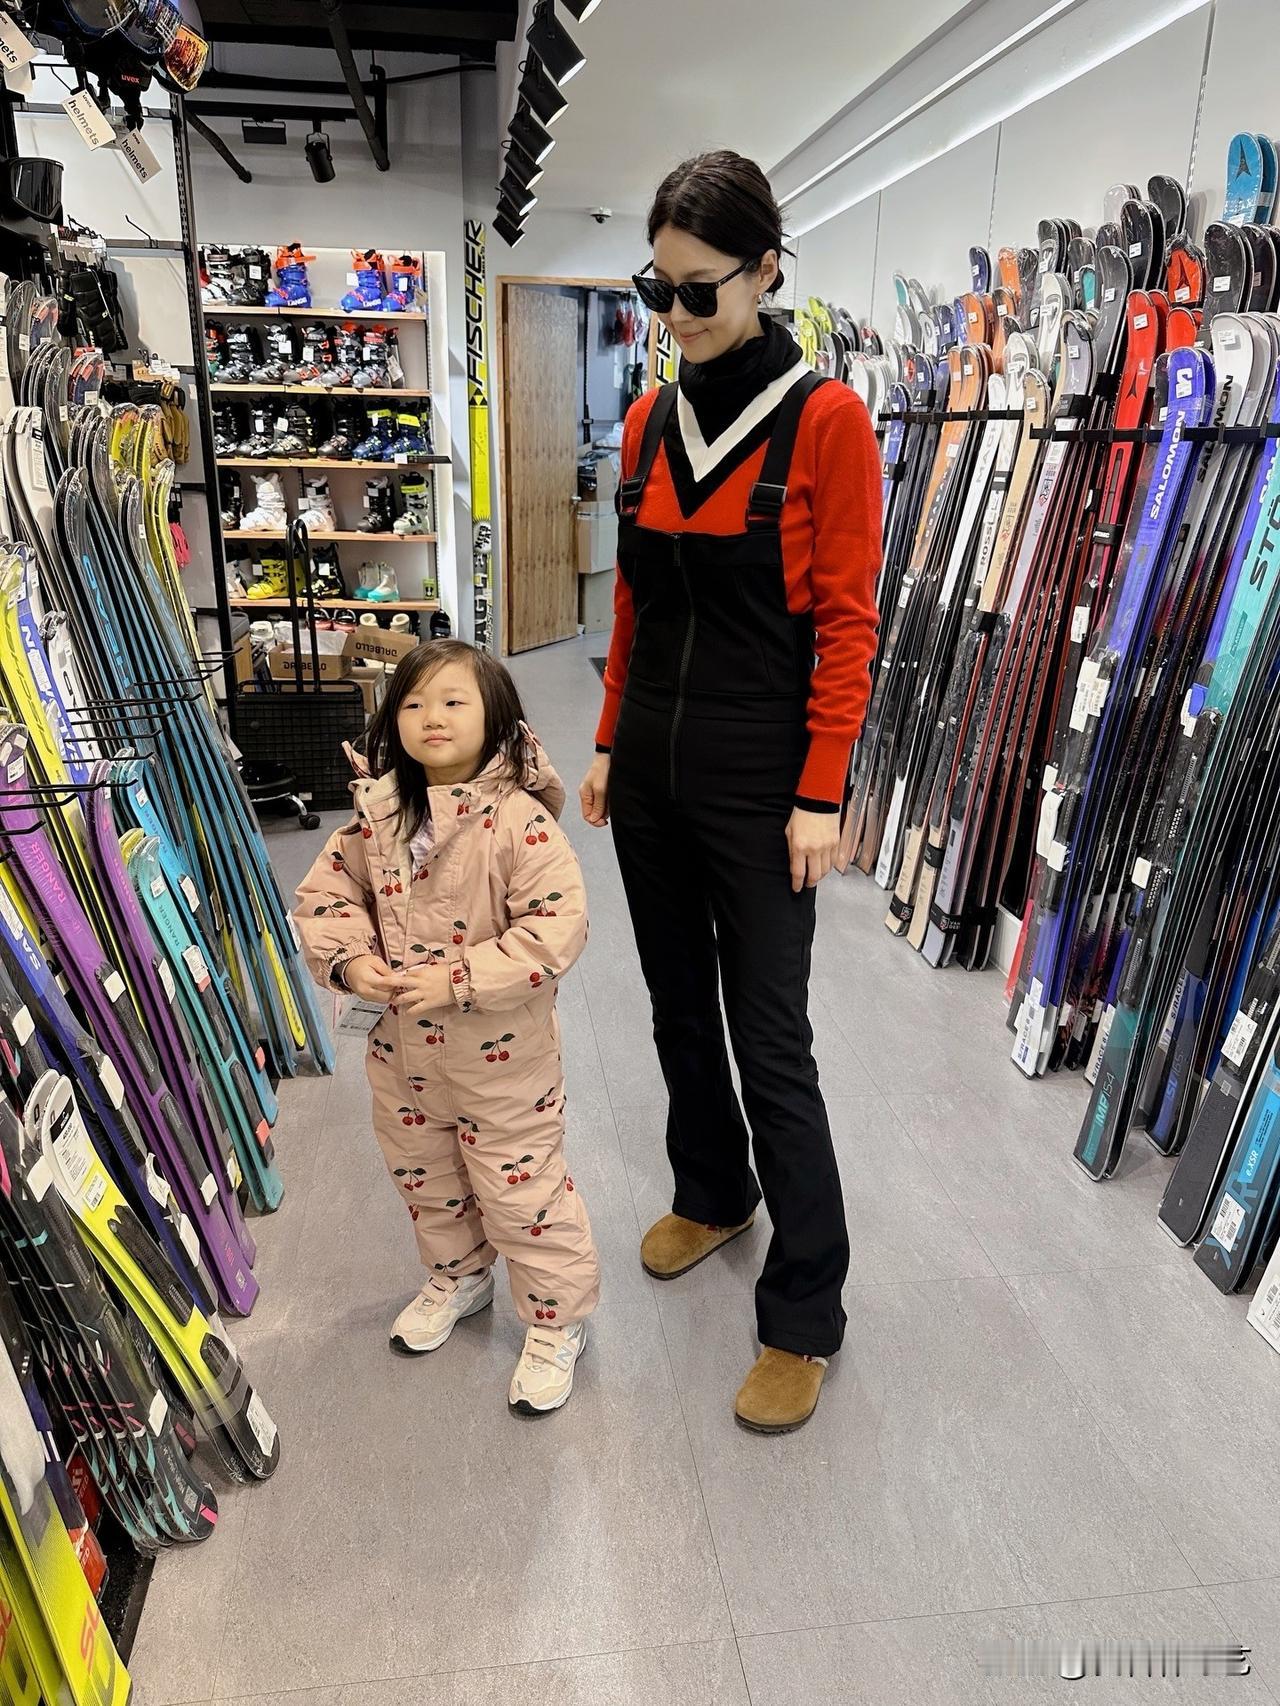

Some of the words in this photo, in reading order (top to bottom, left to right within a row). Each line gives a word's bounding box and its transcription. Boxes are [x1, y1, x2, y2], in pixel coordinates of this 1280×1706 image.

[121, 74, 140, 83] uvex
[68, 99, 99, 145] helmets
[121, 138, 148, 178] helmets
[465, 219, 483, 387] FISCHER
[1197, 374, 1234, 483] SALMON
[1150, 410, 1185, 520] SALOMON
[83, 553, 131, 689] HEAD
[355, 641, 398, 658] DALBELLO
[30, 841, 66, 904] RANGER
[159, 904, 180, 947] RANGER
